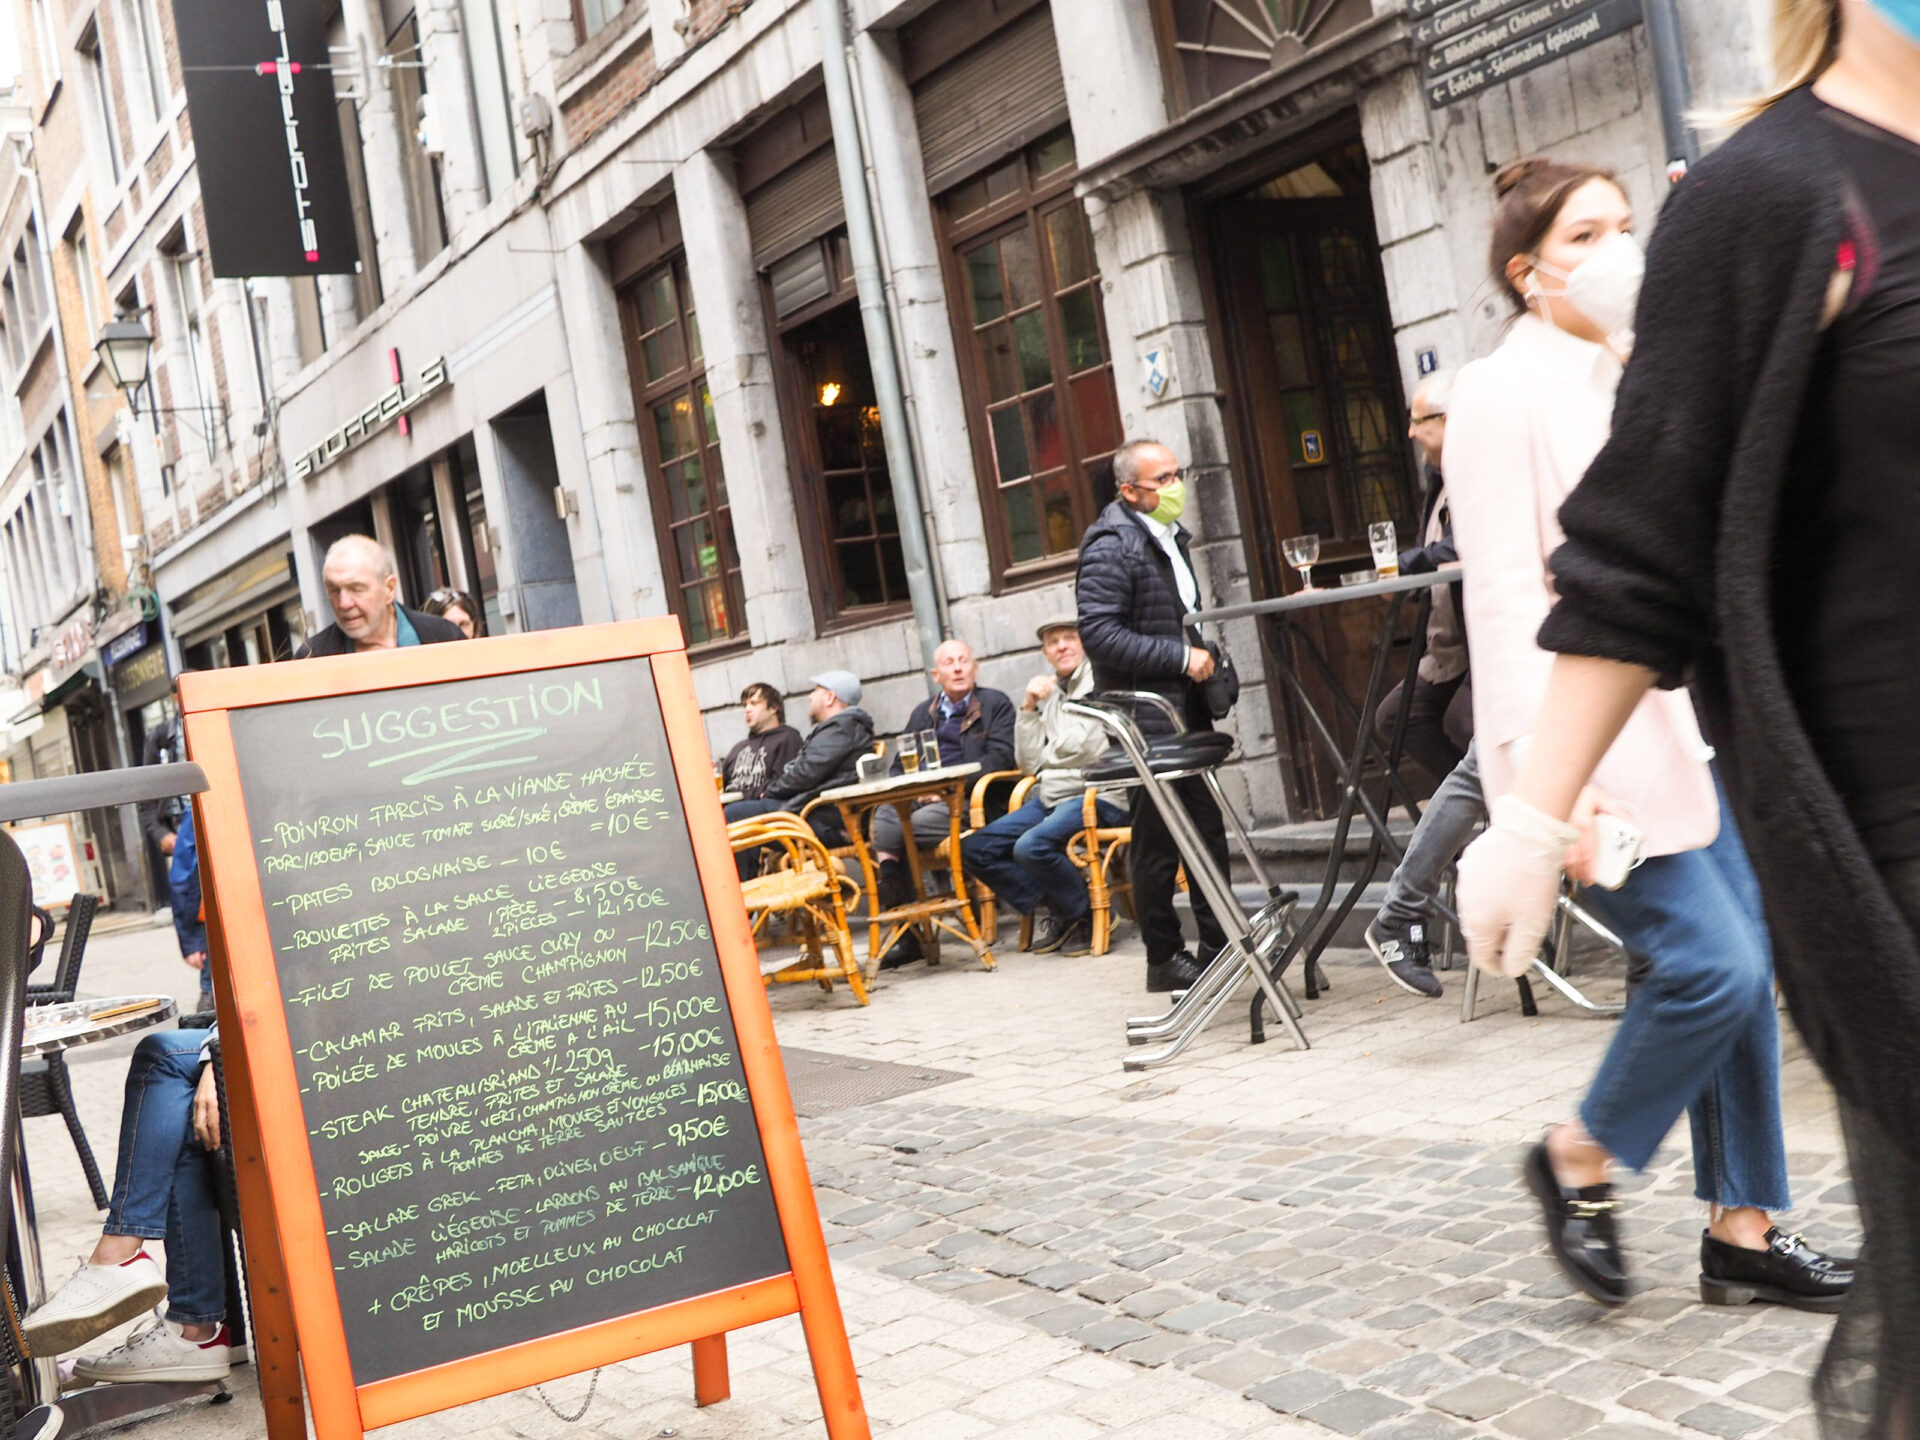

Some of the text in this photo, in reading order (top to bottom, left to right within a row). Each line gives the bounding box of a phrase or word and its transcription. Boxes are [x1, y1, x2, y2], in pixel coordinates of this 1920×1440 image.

[1434, 10, 1468, 35] Centre
[1509, 5, 1552, 34] Chiroux
[1546, 11, 1600, 52] épiscopal
[266, 0, 318, 252] STOFFELS
[293, 355, 449, 480] STOFFELS
[312, 677, 602, 758] SUGGESTION
[474, 786, 501, 804] LA
[503, 772, 572, 799] VIANDE
[579, 752, 656, 787] HACHÉE
[364, 832, 415, 856] SAUCE
[421, 821, 473, 843] TOMATE
[604, 786, 664, 809] ÉPAISSE
[370, 854, 491, 892] BOLOGNAISE
[526, 840, 566, 864] 10€
[327, 936, 391, 964] FRITES
[402, 917, 468, 943] SALADE
[573, 875, 645, 905] 8,50€
[424, 901, 449, 916] LA
[453, 884, 516, 910] SAUCE
[597, 887, 669, 918] 12,50€
[368, 972, 394, 992] DE
[403, 956, 474, 986] POULET
[482, 944, 536, 968] SAUCE
[593, 927, 615, 943] OU
[521, 946, 626, 983] CHAMPIGNON
[478, 994, 538, 1019] SALADE
[542, 989, 561, 1004] ET
[565, 978, 618, 1001] FRITES
[386, 1052, 407, 1072] DE
[415, 1036, 483, 1063] MOULES
[603, 1001, 627, 1019] AU
[401, 1063, 541, 1114] CHATEAUBRIAND
[413, 1120, 473, 1147] POIVRE
[645, 1072, 660, 1086] OU
[483, 1083, 540, 1110] FRITES
[544, 1077, 565, 1094] ET
[573, 1063, 628, 1087] SALADE
[439, 1148, 461, 1163] LA
[548, 1104, 604, 1133] MOULES
[606, 1097, 623, 1114] ET
[445, 1149, 504, 1175] POMMES
[515, 1138, 534, 1154] DE
[537, 1127, 585, 1148] TERRE
[427, 1190, 481, 1212] GREK
[598, 1140, 648, 1166] OEUF
[667, 1114, 730, 1147] 9,50€
[430, 1207, 520, 1242] LIÉGEOISE
[607, 1178, 627, 1194] AU
[637, 1152, 725, 1188] BALSAMIQUE
[434, 1231, 506, 1264] HARICOTS
[513, 1225, 531, 1241] ET
[539, 1208, 595, 1236] POMMES
[605, 1197, 627, 1217] DE
[631, 1184, 676, 1207] TERRE
[389, 1271, 472, 1311] CRÊPES
[602, 1235, 621, 1250] AU
[631, 1208, 719, 1242] CHOCOLAT
[421, 1245, 686, 1331] ET MOUSSE AU CHOCOLAT
